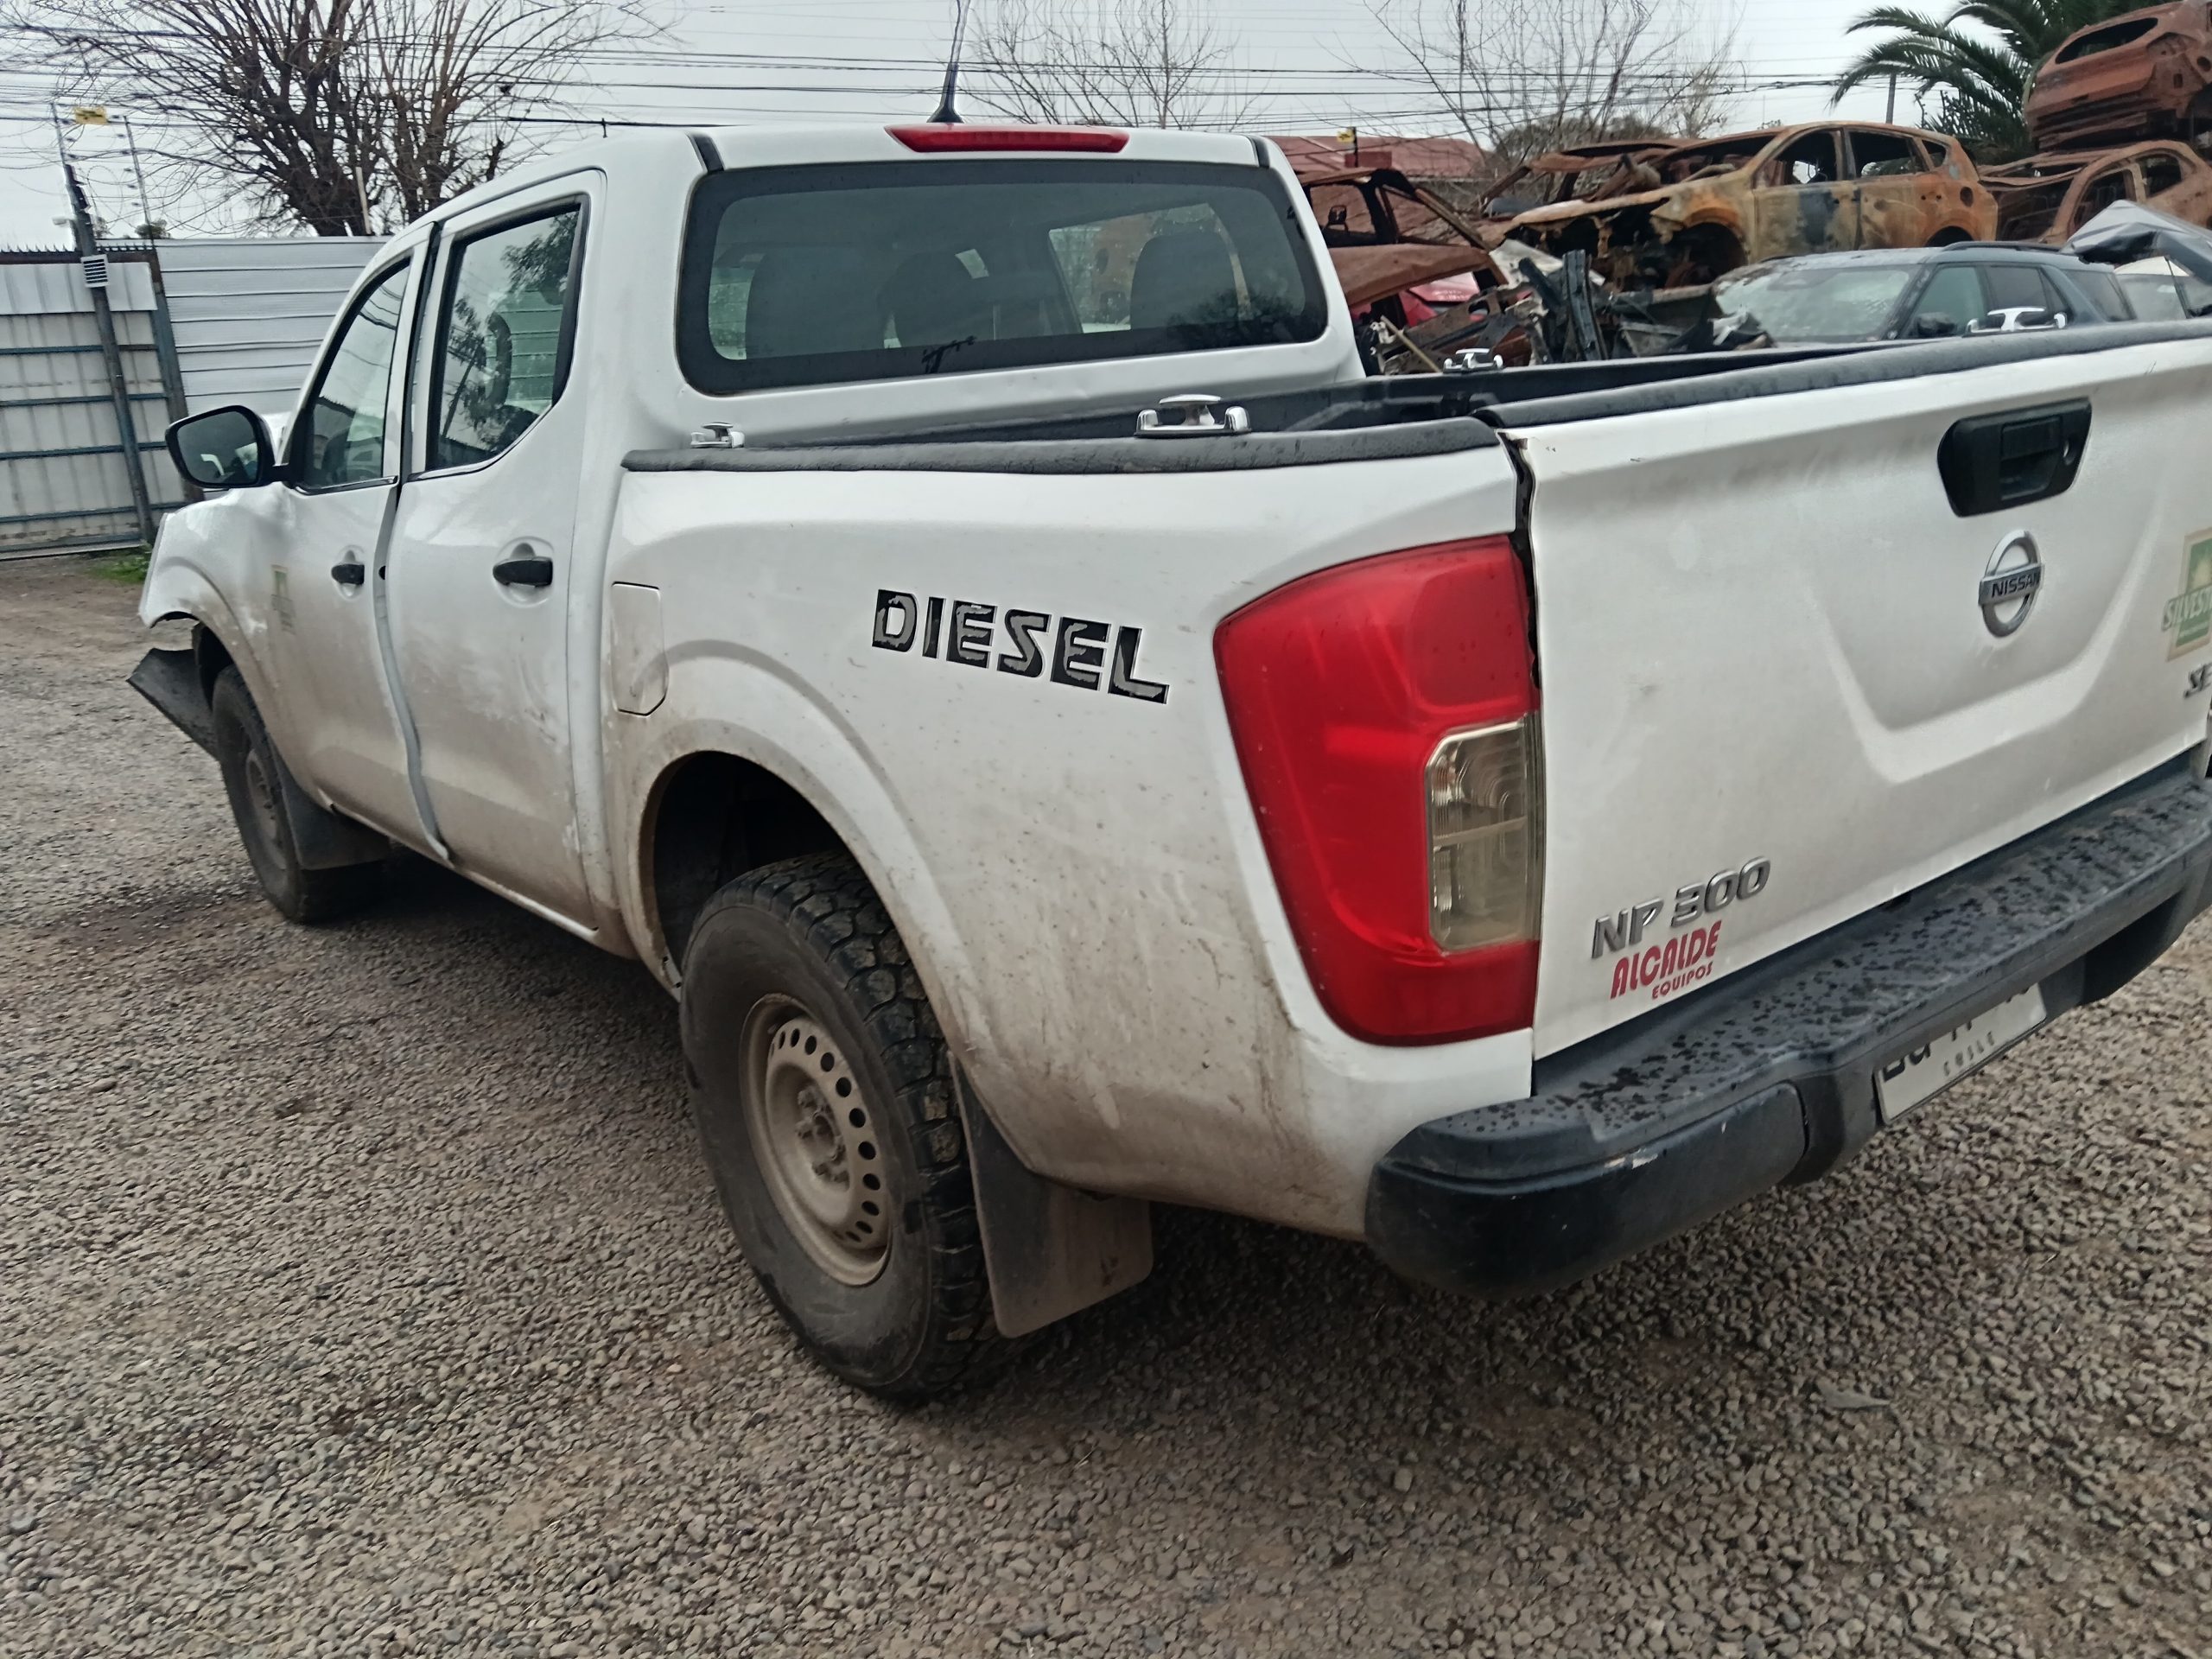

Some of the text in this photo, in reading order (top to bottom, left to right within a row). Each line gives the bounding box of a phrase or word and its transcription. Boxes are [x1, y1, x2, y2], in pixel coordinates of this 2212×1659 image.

[872, 589, 1169, 704] DIESEL
[1592, 855, 1771, 959] NP 300
[1652, 961, 1713, 1000] EQUIPOS
